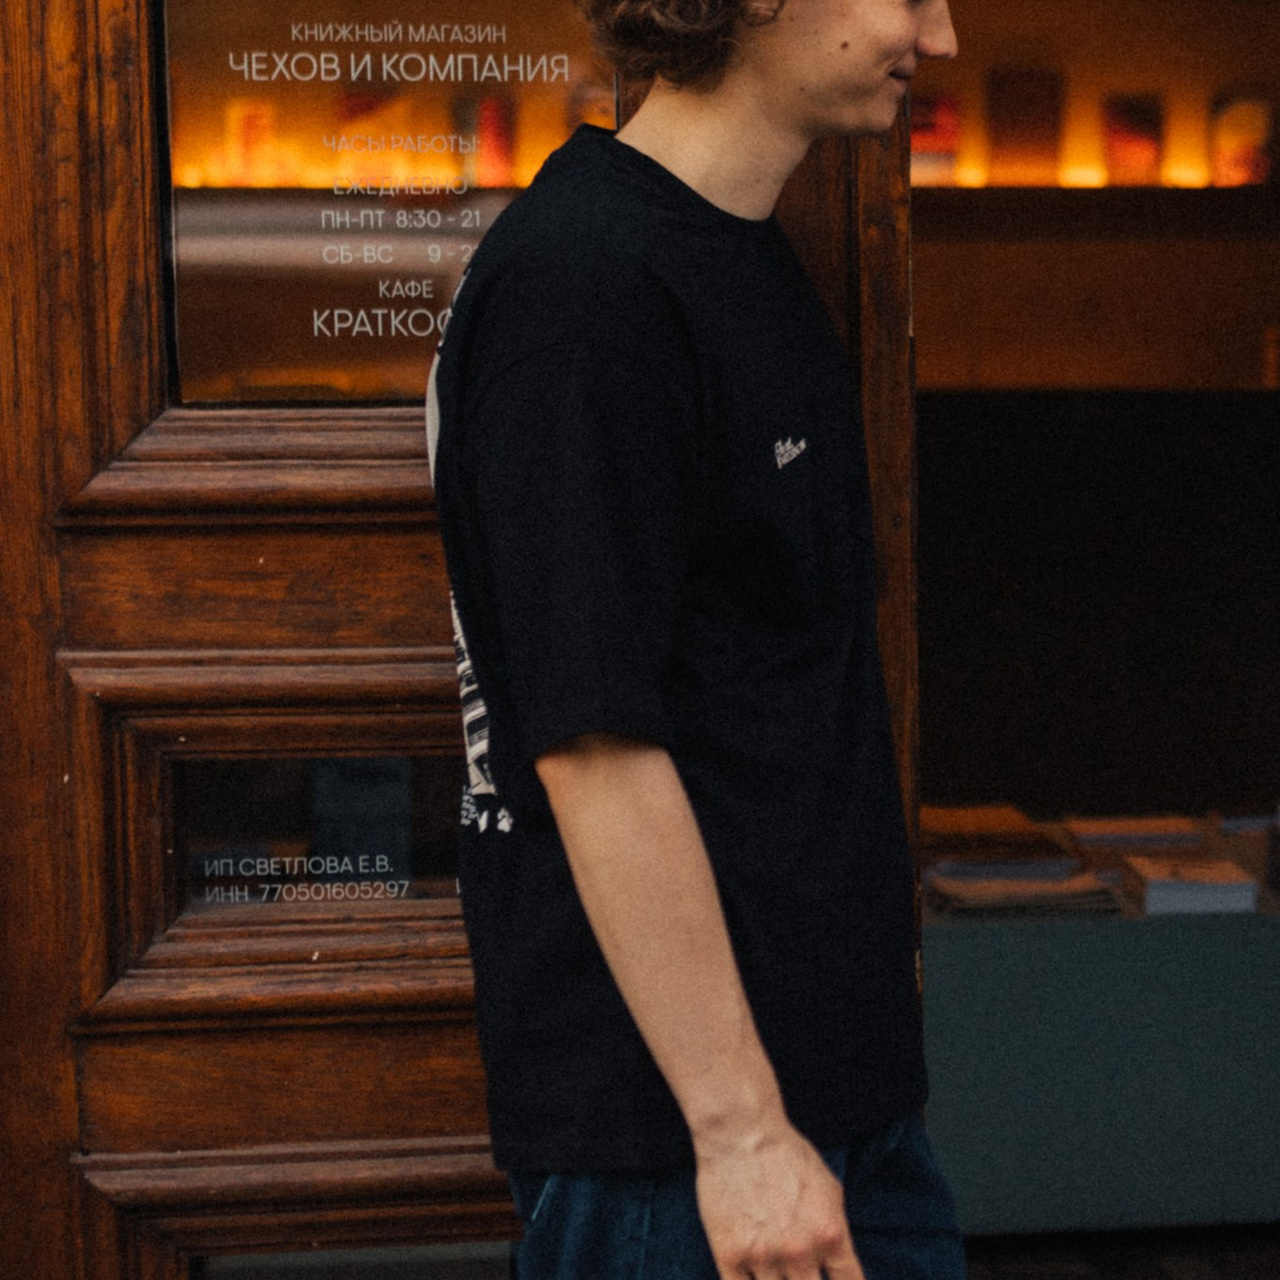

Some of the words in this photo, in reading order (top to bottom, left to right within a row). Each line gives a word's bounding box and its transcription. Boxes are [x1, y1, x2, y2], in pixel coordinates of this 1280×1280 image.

[292, 21, 402, 43] КНИЖНЫЙ
[408, 24, 506, 43] МАГАЗИН
[229, 52, 341, 81] ЧЕХОВ
[351, 52, 372, 81] И
[382, 53, 569, 82] КОМПАНИЯ
[323, 135, 385, 152] ЧАСЫ
[333, 176, 468, 197] ЕЖЕДНЕВНО
[321, 210, 385, 228] ПН-ПТ
[396, 210, 441, 228] 8:30
[460, 210, 480, 228] 21
[322, 245, 394, 264] СБ-ВС
[428, 244, 441, 263] 9
[461, 245, 478, 263] 2
[379, 280, 433, 298] КАФЕ
[204, 859, 233, 876] ИП
[239, 856, 353, 876] СВЕТЛОВА
[359, 855, 393, 873] Е.В.
[204, 886, 248, 903] ИНН
[259, 880, 409, 902] 770501605297
